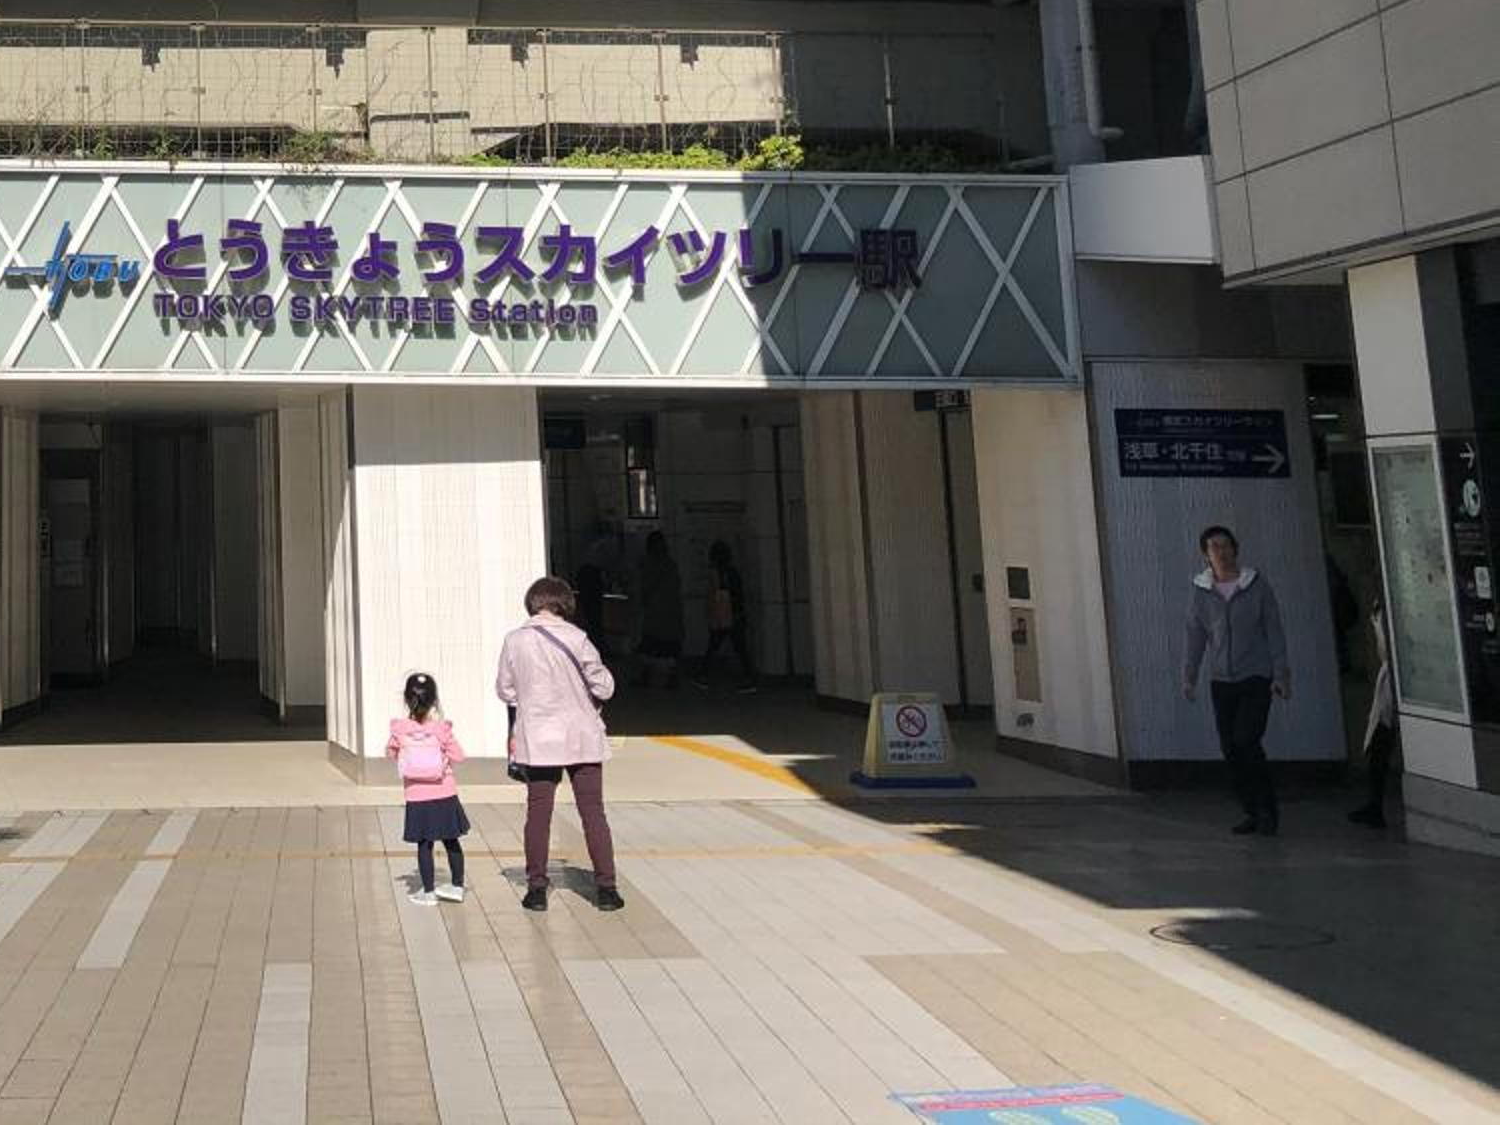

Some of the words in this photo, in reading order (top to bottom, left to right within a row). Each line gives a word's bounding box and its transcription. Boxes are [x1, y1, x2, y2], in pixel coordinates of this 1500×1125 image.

[154, 219, 921, 290] とうきょうスカイツリー駅
[156, 293, 273, 320] TOKYO
[290, 295, 455, 323] SKYTREE
[470, 296, 598, 324] Station
